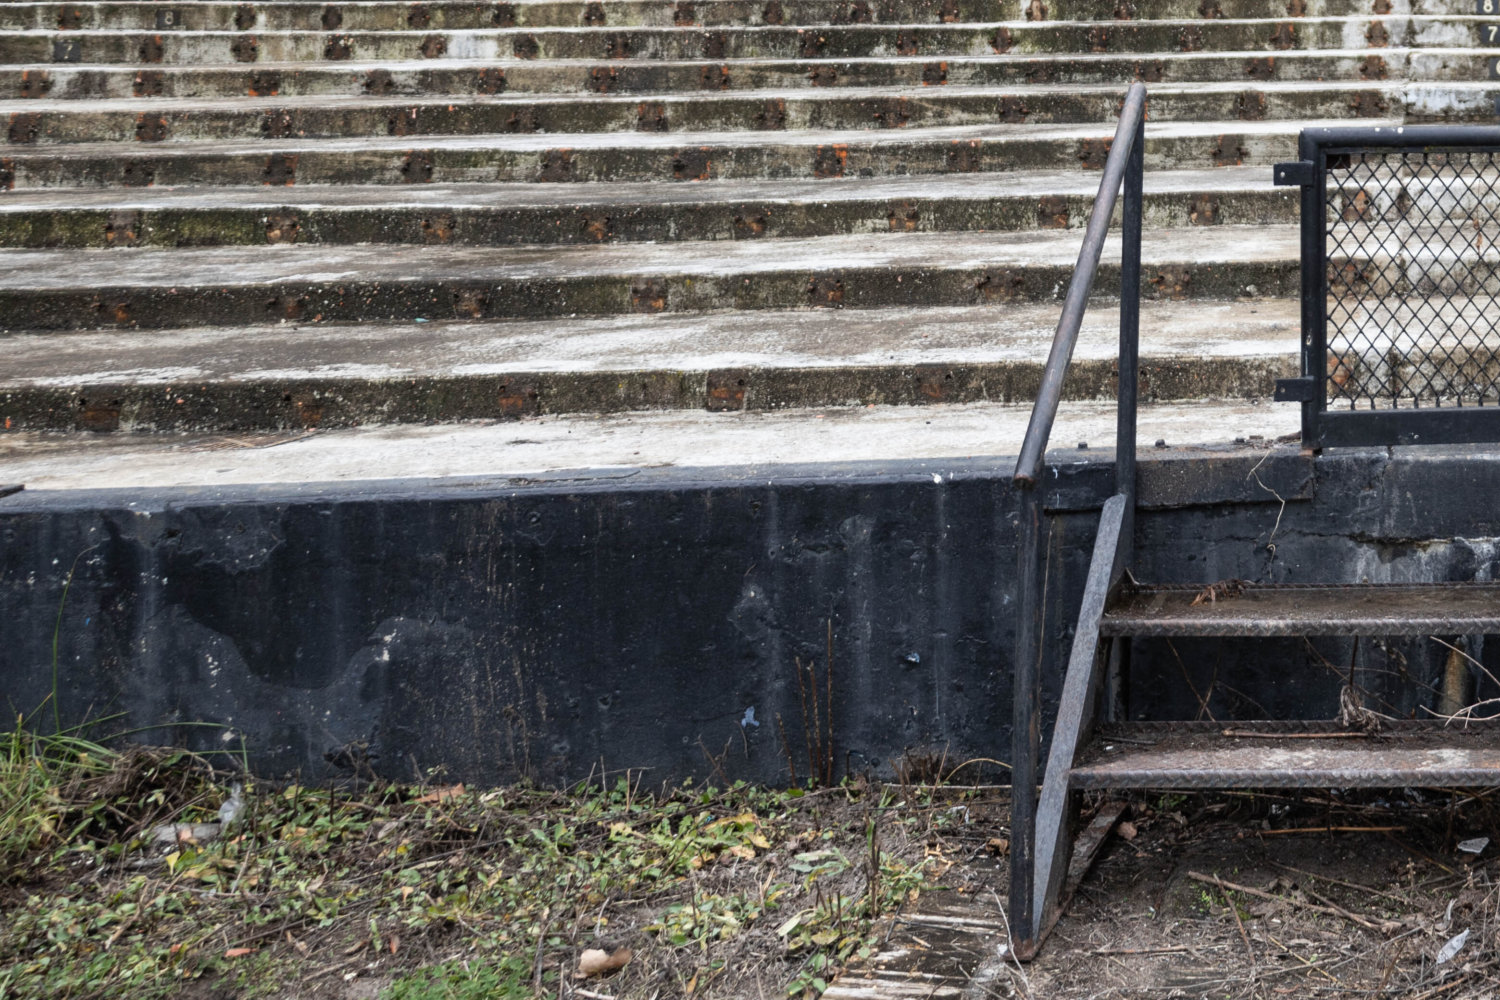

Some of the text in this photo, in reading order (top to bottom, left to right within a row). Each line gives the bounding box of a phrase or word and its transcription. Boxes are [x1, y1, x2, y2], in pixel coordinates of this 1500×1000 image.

[164, 10, 174, 25] 8
[1487, 25, 1498, 42] 7
[63, 43, 73, 60] 7
